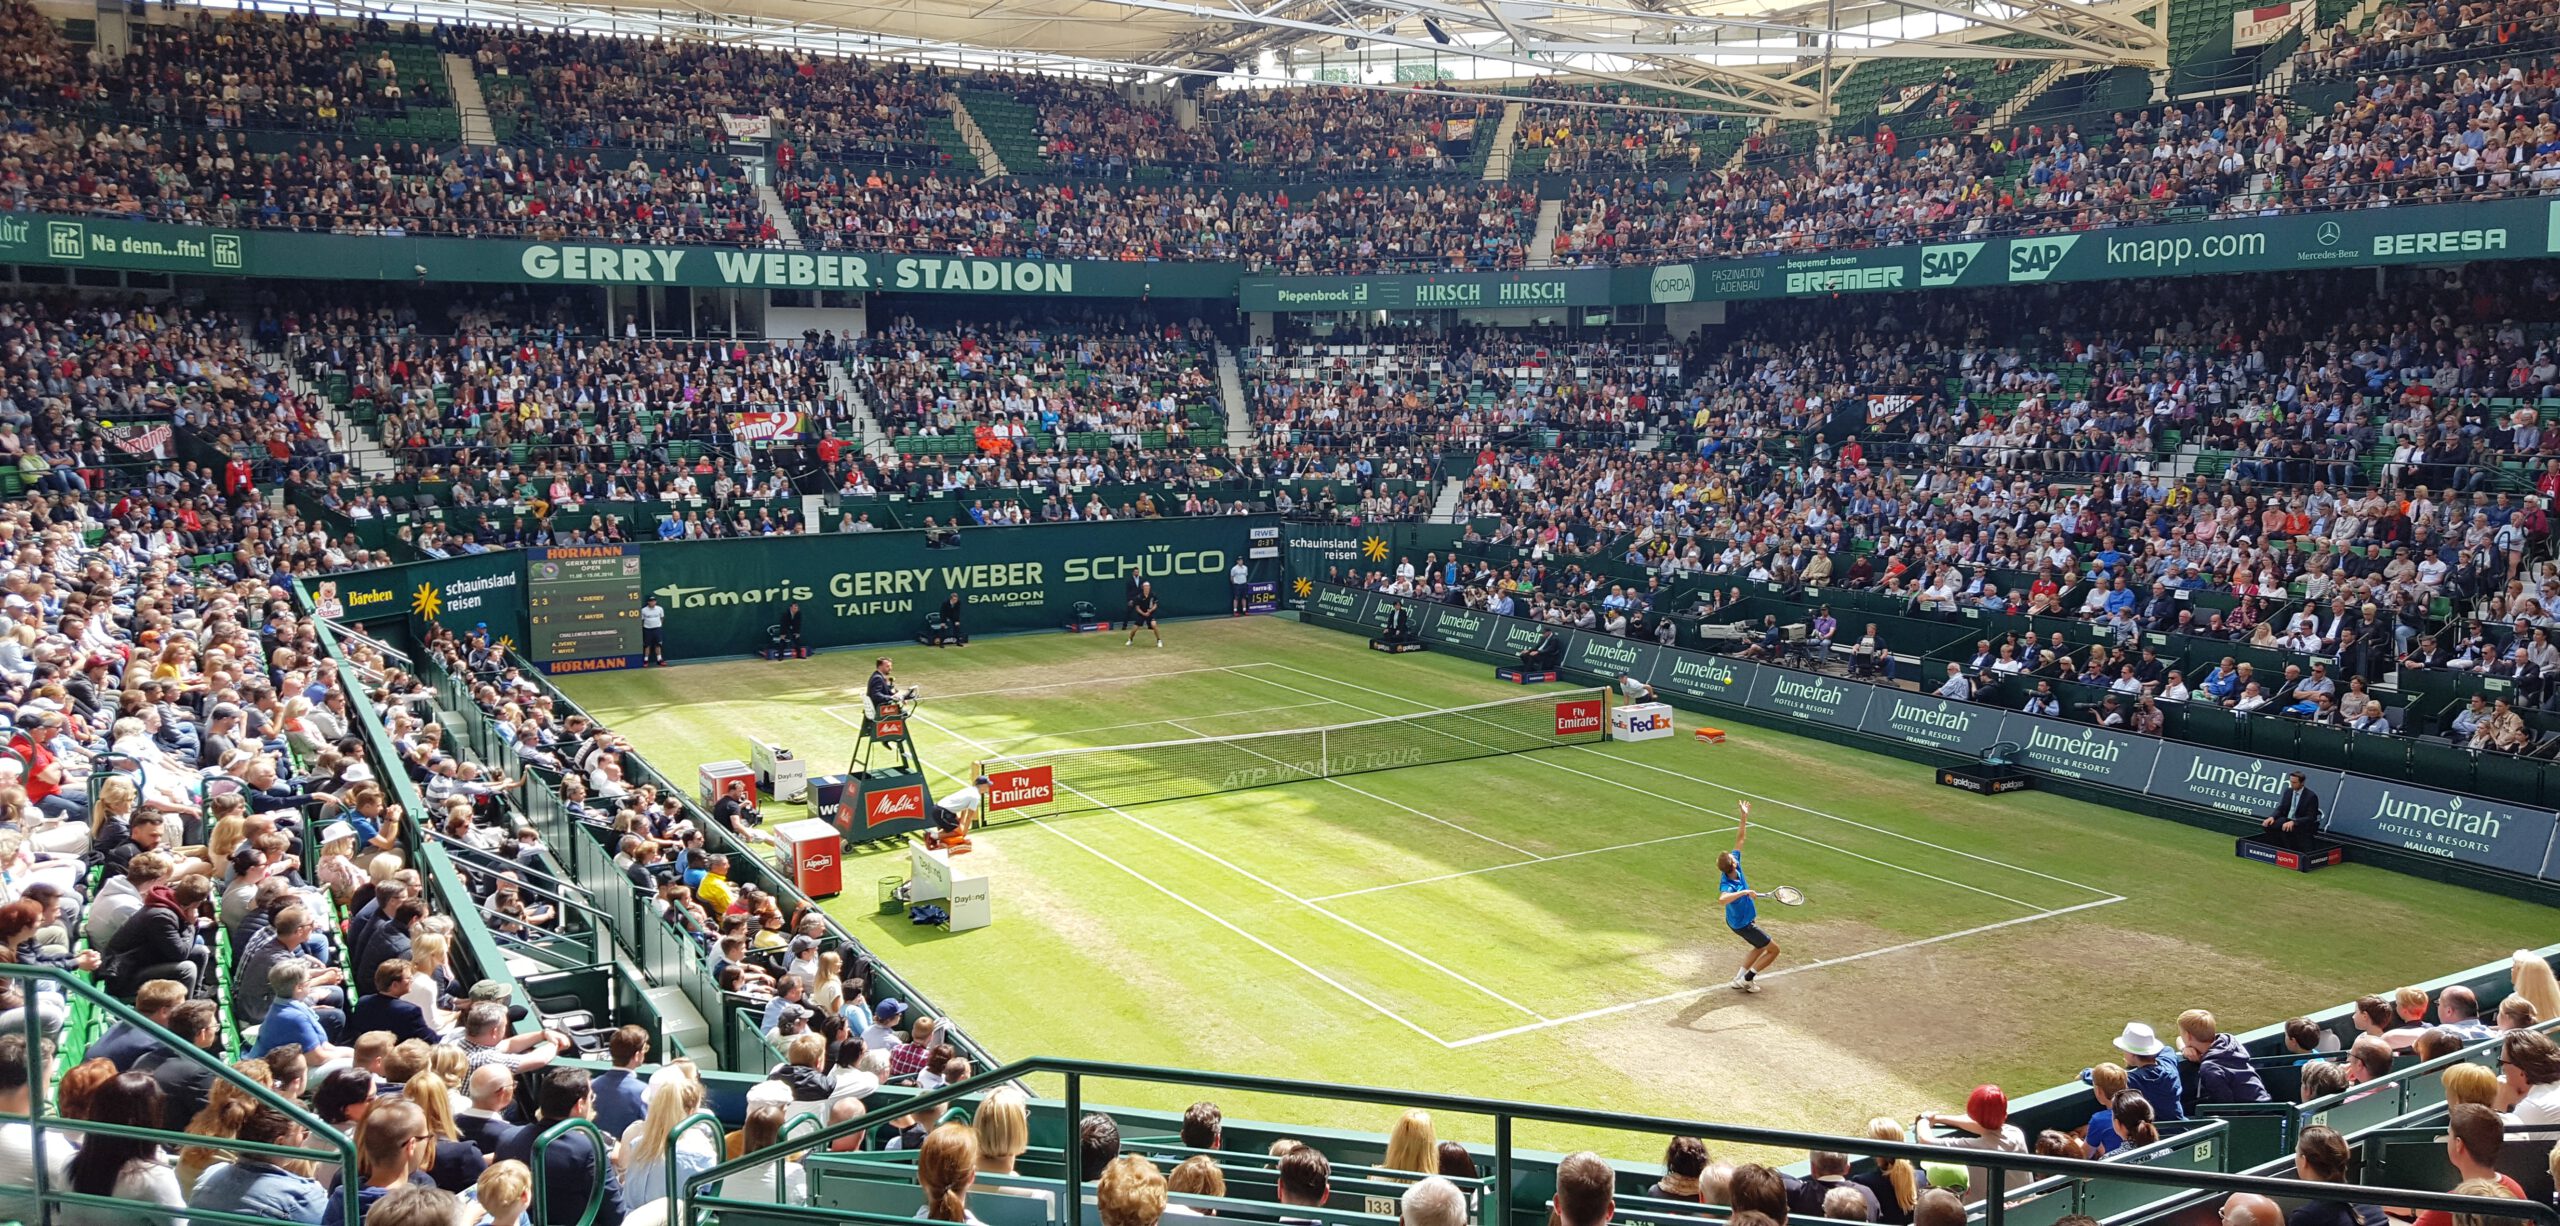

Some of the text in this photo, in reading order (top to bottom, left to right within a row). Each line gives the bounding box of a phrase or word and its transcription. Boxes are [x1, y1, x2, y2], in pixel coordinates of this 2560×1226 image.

[92, 234, 205, 258] Na denn...ffn!
[2107, 232, 2265, 267] knapp.com
[2373, 228, 2507, 255] BERESA
[2010, 244, 2062, 274] SAP
[2297, 249, 2359, 260] Mercedes-Benz
[522, 245, 1072, 292] GERRY WEBER STADION
[1787, 258, 1829, 271] bequemer
[1831, 256, 1857, 265] bauen
[1922, 251, 1968, 278] SAP
[1712, 268, 1764, 281] FASZINATION
[1787, 266, 1903, 293] BREMER
[1416, 284, 1481, 301] HIRSCH
[1500, 282, 1565, 299] HIRSCH
[1655, 277, 1691, 293] KORDA
[1715, 281, 1760, 293] LADENBAU
[1278, 289, 1349, 303] Piepenbrock
[1290, 537, 1357, 548] schauinsland
[1064, 545, 1224, 582] SCHÜCO
[1325, 551, 1357, 560] reisen
[446, 571, 516, 596] schauinsland
[830, 562, 1043, 597] GERRY WEBER
[653, 579, 813, 608] Tamaris
[968, 591, 1044, 603] SAMOON
[1252, 593, 1268, 603] 158
[1317, 587, 1354, 606] Jumeirah
[447, 595, 481, 611] reisen
[834, 599, 912, 616] TAIFUN
[533, 616, 539, 624] 6
[1436, 610, 1480, 631] Jumeirah
[1506, 624, 1543, 644] Jumeir
[1582, 639, 1637, 664] Jumeirah
[1584, 658, 1603, 667] HOTELS
[1608, 663, 1630, 672] RESORTS
[1670, 656, 1732, 682] Jumeirah
[1673, 677, 1694, 686] HOTELS
[1700, 682, 1725, 692] RESORTS
[1771, 675, 1842, 705] Jumeirah
[1572, 707, 1585, 717] Fly
[1774, 697, 1798, 708] HOTELS
[1806, 703, 1834, 716] RESORTS
[1793, 711, 1809, 719] DUBAI
[1558, 716, 1598, 729] Emirates
[1630, 714, 1672, 733] FedEx
[1888, 699, 1970, 732] Jumeirah
[1892, 723, 1920, 734] HOTELS
[1928, 730, 1961, 743] RESORTS
[1906, 736, 1940, 748] FRANKFURT
[2024, 725, 2119, 762] Jumeirah
[1222, 748, 1422, 788] ATP WORLD TOUR
[2028, 751, 2061, 764] HOTELS
[2072, 760, 2111, 775] RESORTS
[2051, 767, 2081, 779] LONDON
[1012, 777, 1029, 788] Fly
[1953, 777, 1981, 790] goldgas
[2000, 780, 2024, 791] goldgas
[992, 785, 1049, 804] Emirates
[2189, 784, 2227, 799] HOTELS
[2239, 794, 2279, 809] RESORT
[873, 793, 917, 817] Melitta
[2213, 801, 2253, 815] MALDIVES
[2370, 791, 2500, 838] Jumeirah
[2378, 822, 2422, 838] HOTELS
[2437, 834, 2490, 852] RESORTS
[2404, 841, 2455, 858] MALLORCA
[2277, 854, 2294, 864] sports
[2197, 1145, 2208, 1158] 35
[1367, 1200, 1392, 1215] 133
